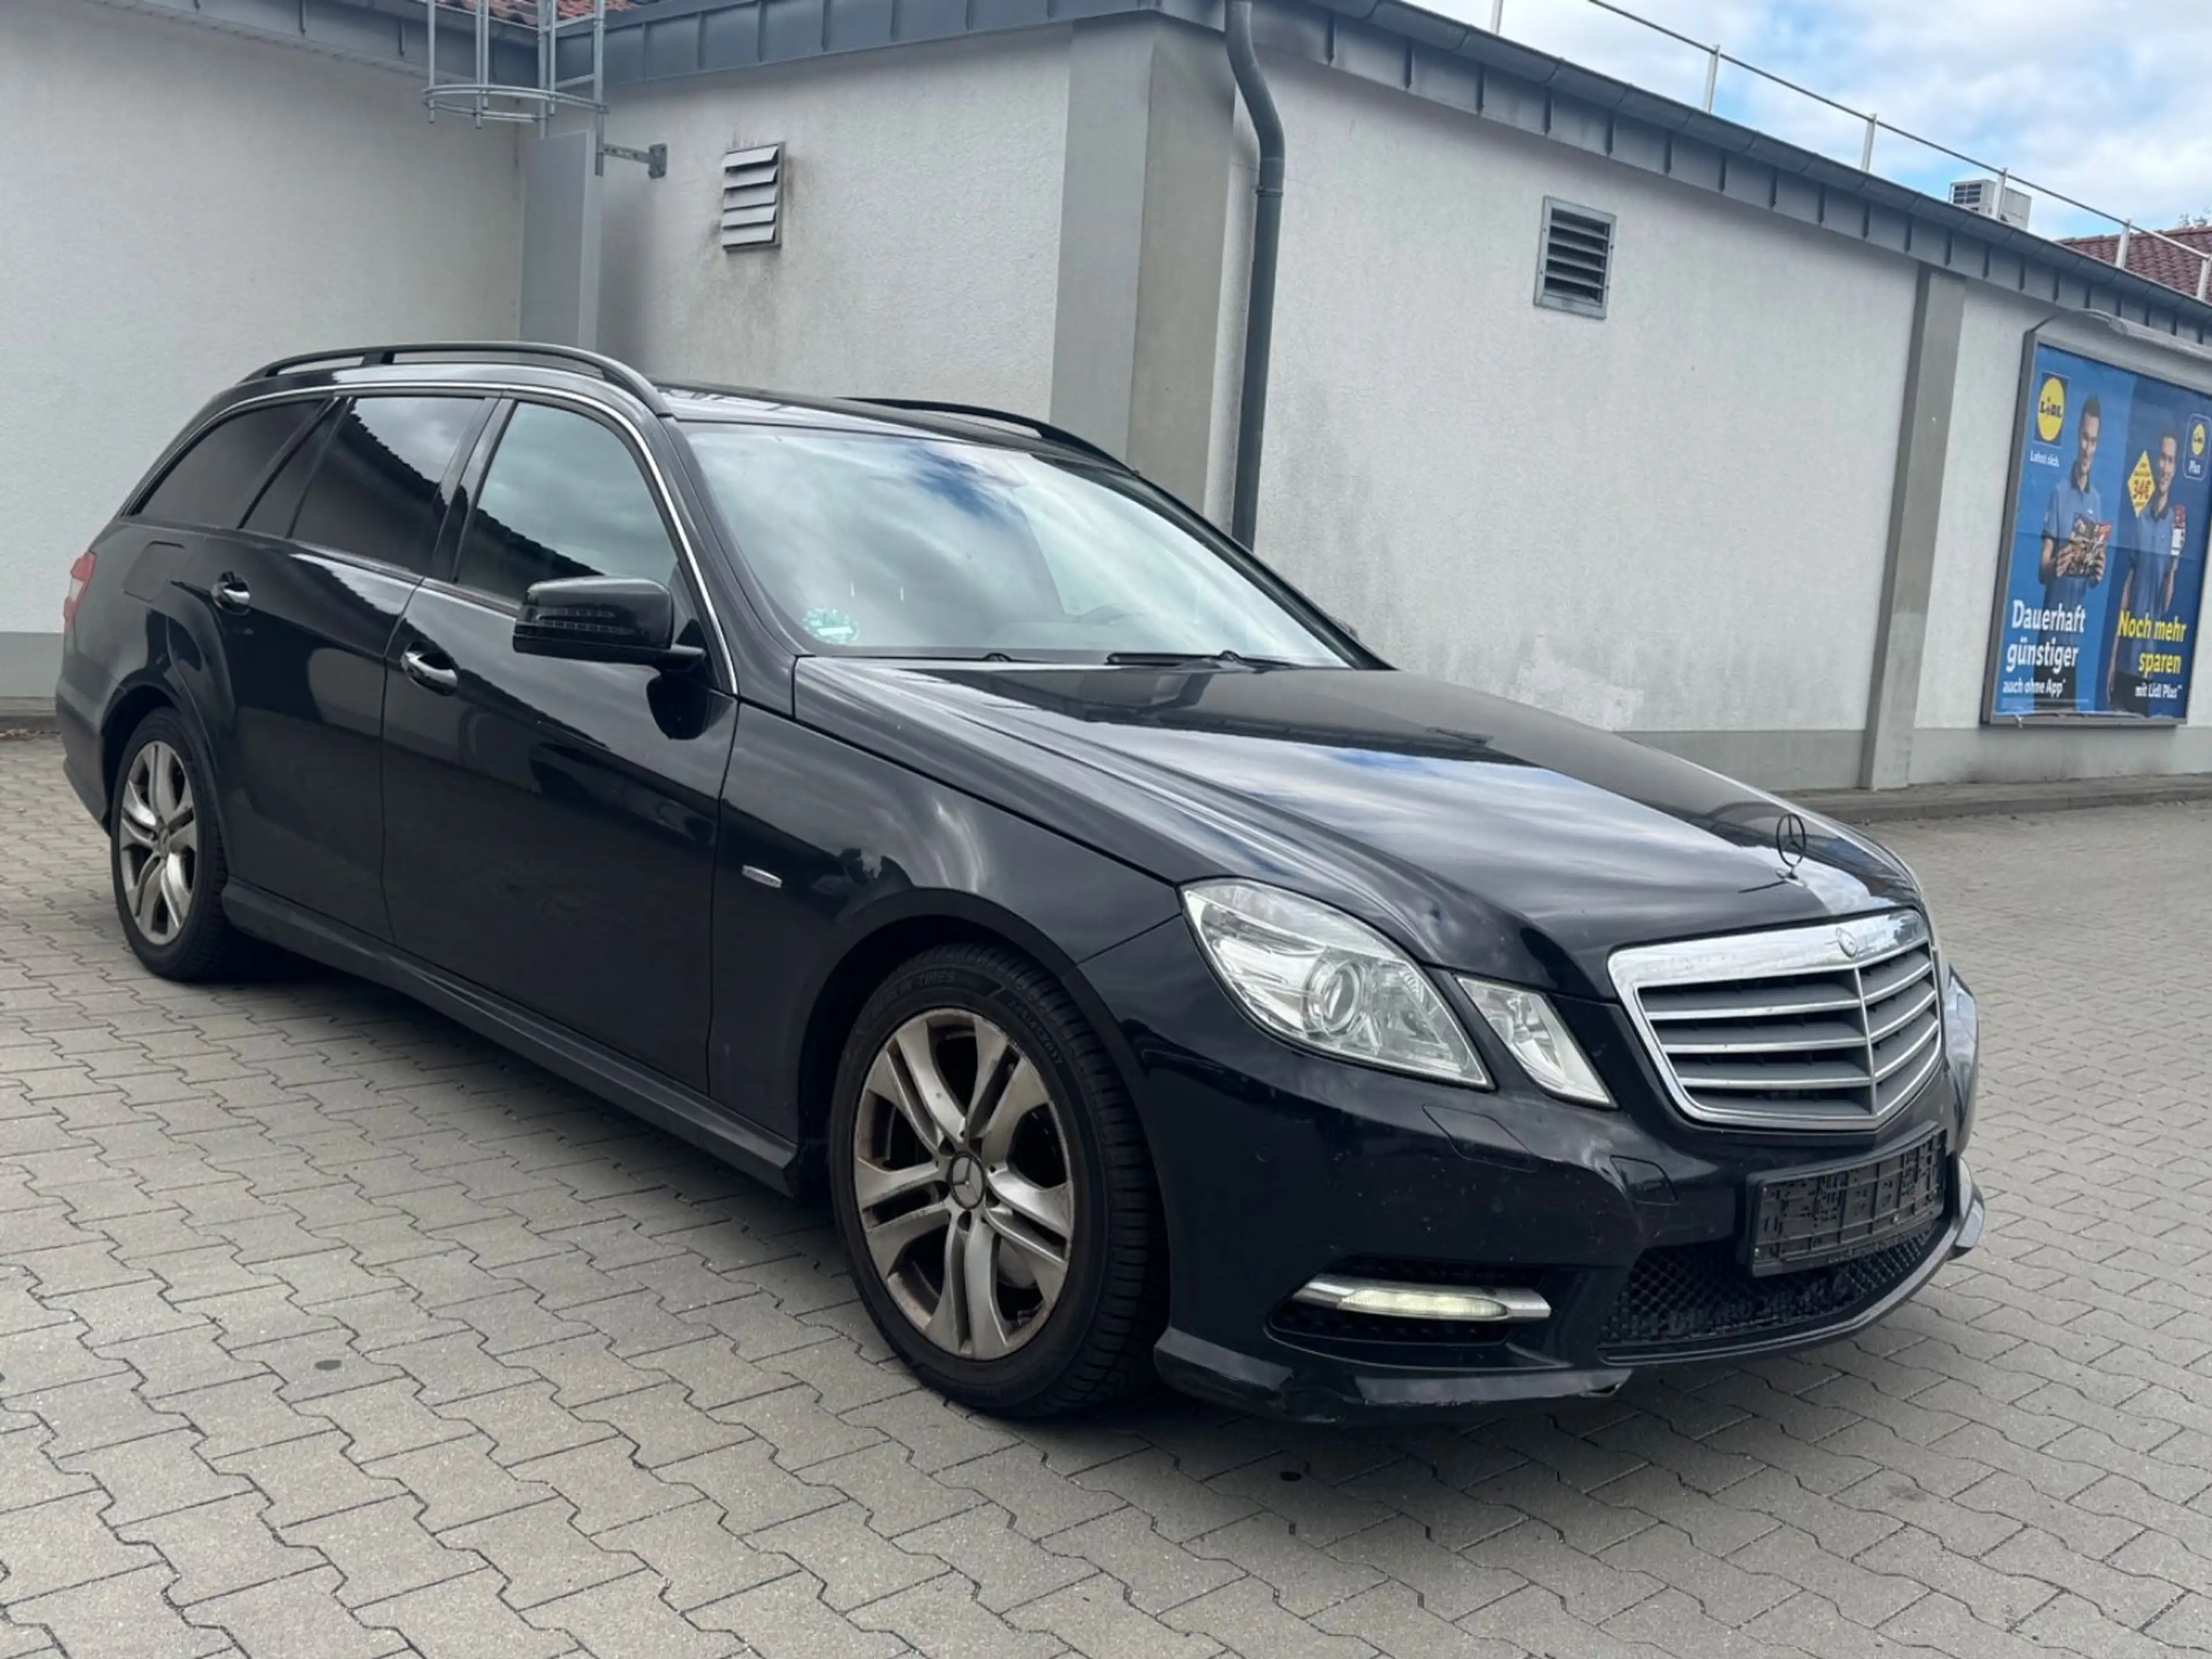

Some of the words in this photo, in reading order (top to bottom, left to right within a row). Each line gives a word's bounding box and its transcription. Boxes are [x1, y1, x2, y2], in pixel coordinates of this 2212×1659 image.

[2012, 599, 2086, 632] Dauerhaft
[2119, 609, 2150, 639] Noch
[2153, 615, 2187, 642] mehr
[2006, 637, 2079, 675] günstiger
[2138, 652, 2182, 678] sparen
[2002, 677, 2023, 694] auch
[2025, 677, 2045, 694] ohne
[2134, 681, 2147, 698] mit
[2148, 683, 2161, 698] Lidl
